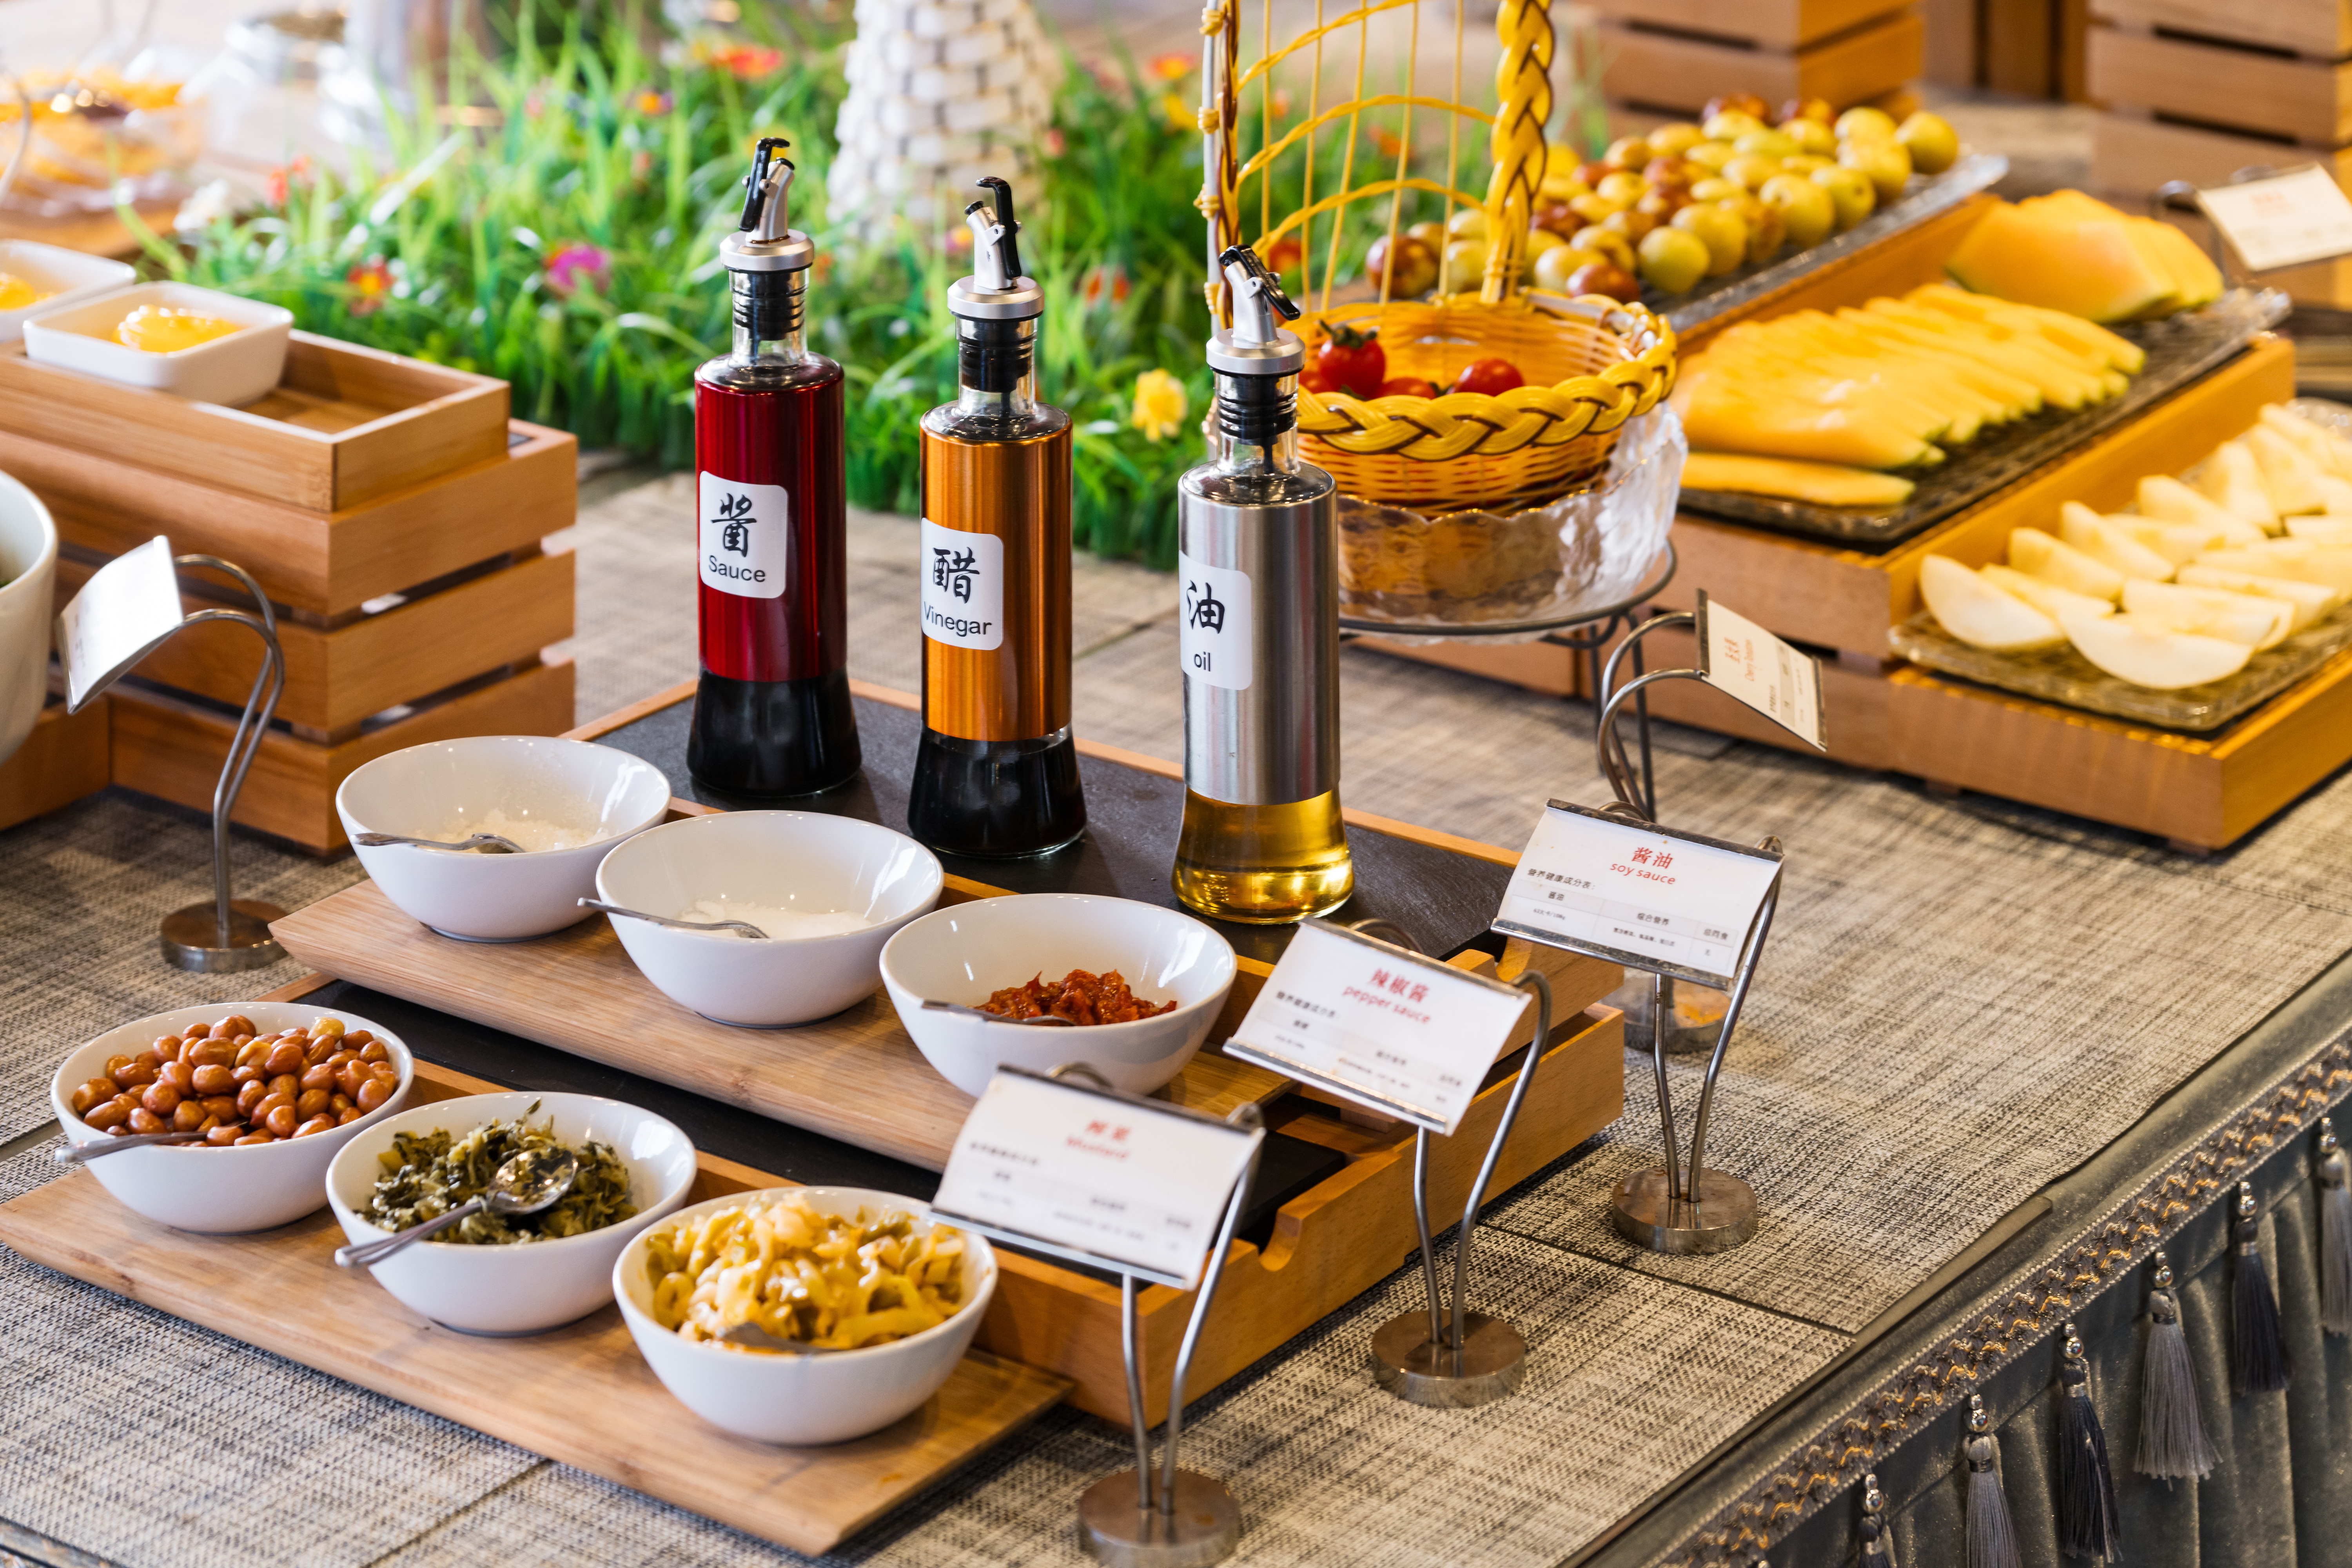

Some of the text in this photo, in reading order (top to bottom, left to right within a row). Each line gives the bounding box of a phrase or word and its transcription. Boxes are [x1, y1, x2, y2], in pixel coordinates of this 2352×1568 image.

[709, 555, 766, 583] Sauce
[933, 546, 980, 604] 醋
[924, 601, 992, 637] Vinegar
[1186, 579, 1225, 634] 油
[1193, 651, 1211, 672] oil
[1610, 863, 1676, 884] soy sauce
[1632, 847, 1673, 869] 酱油
[1369, 968, 1429, 1003] 辣椒酱
[1342, 986, 1391, 1007] pepper
[1393, 1004, 1431, 1024] sauce
